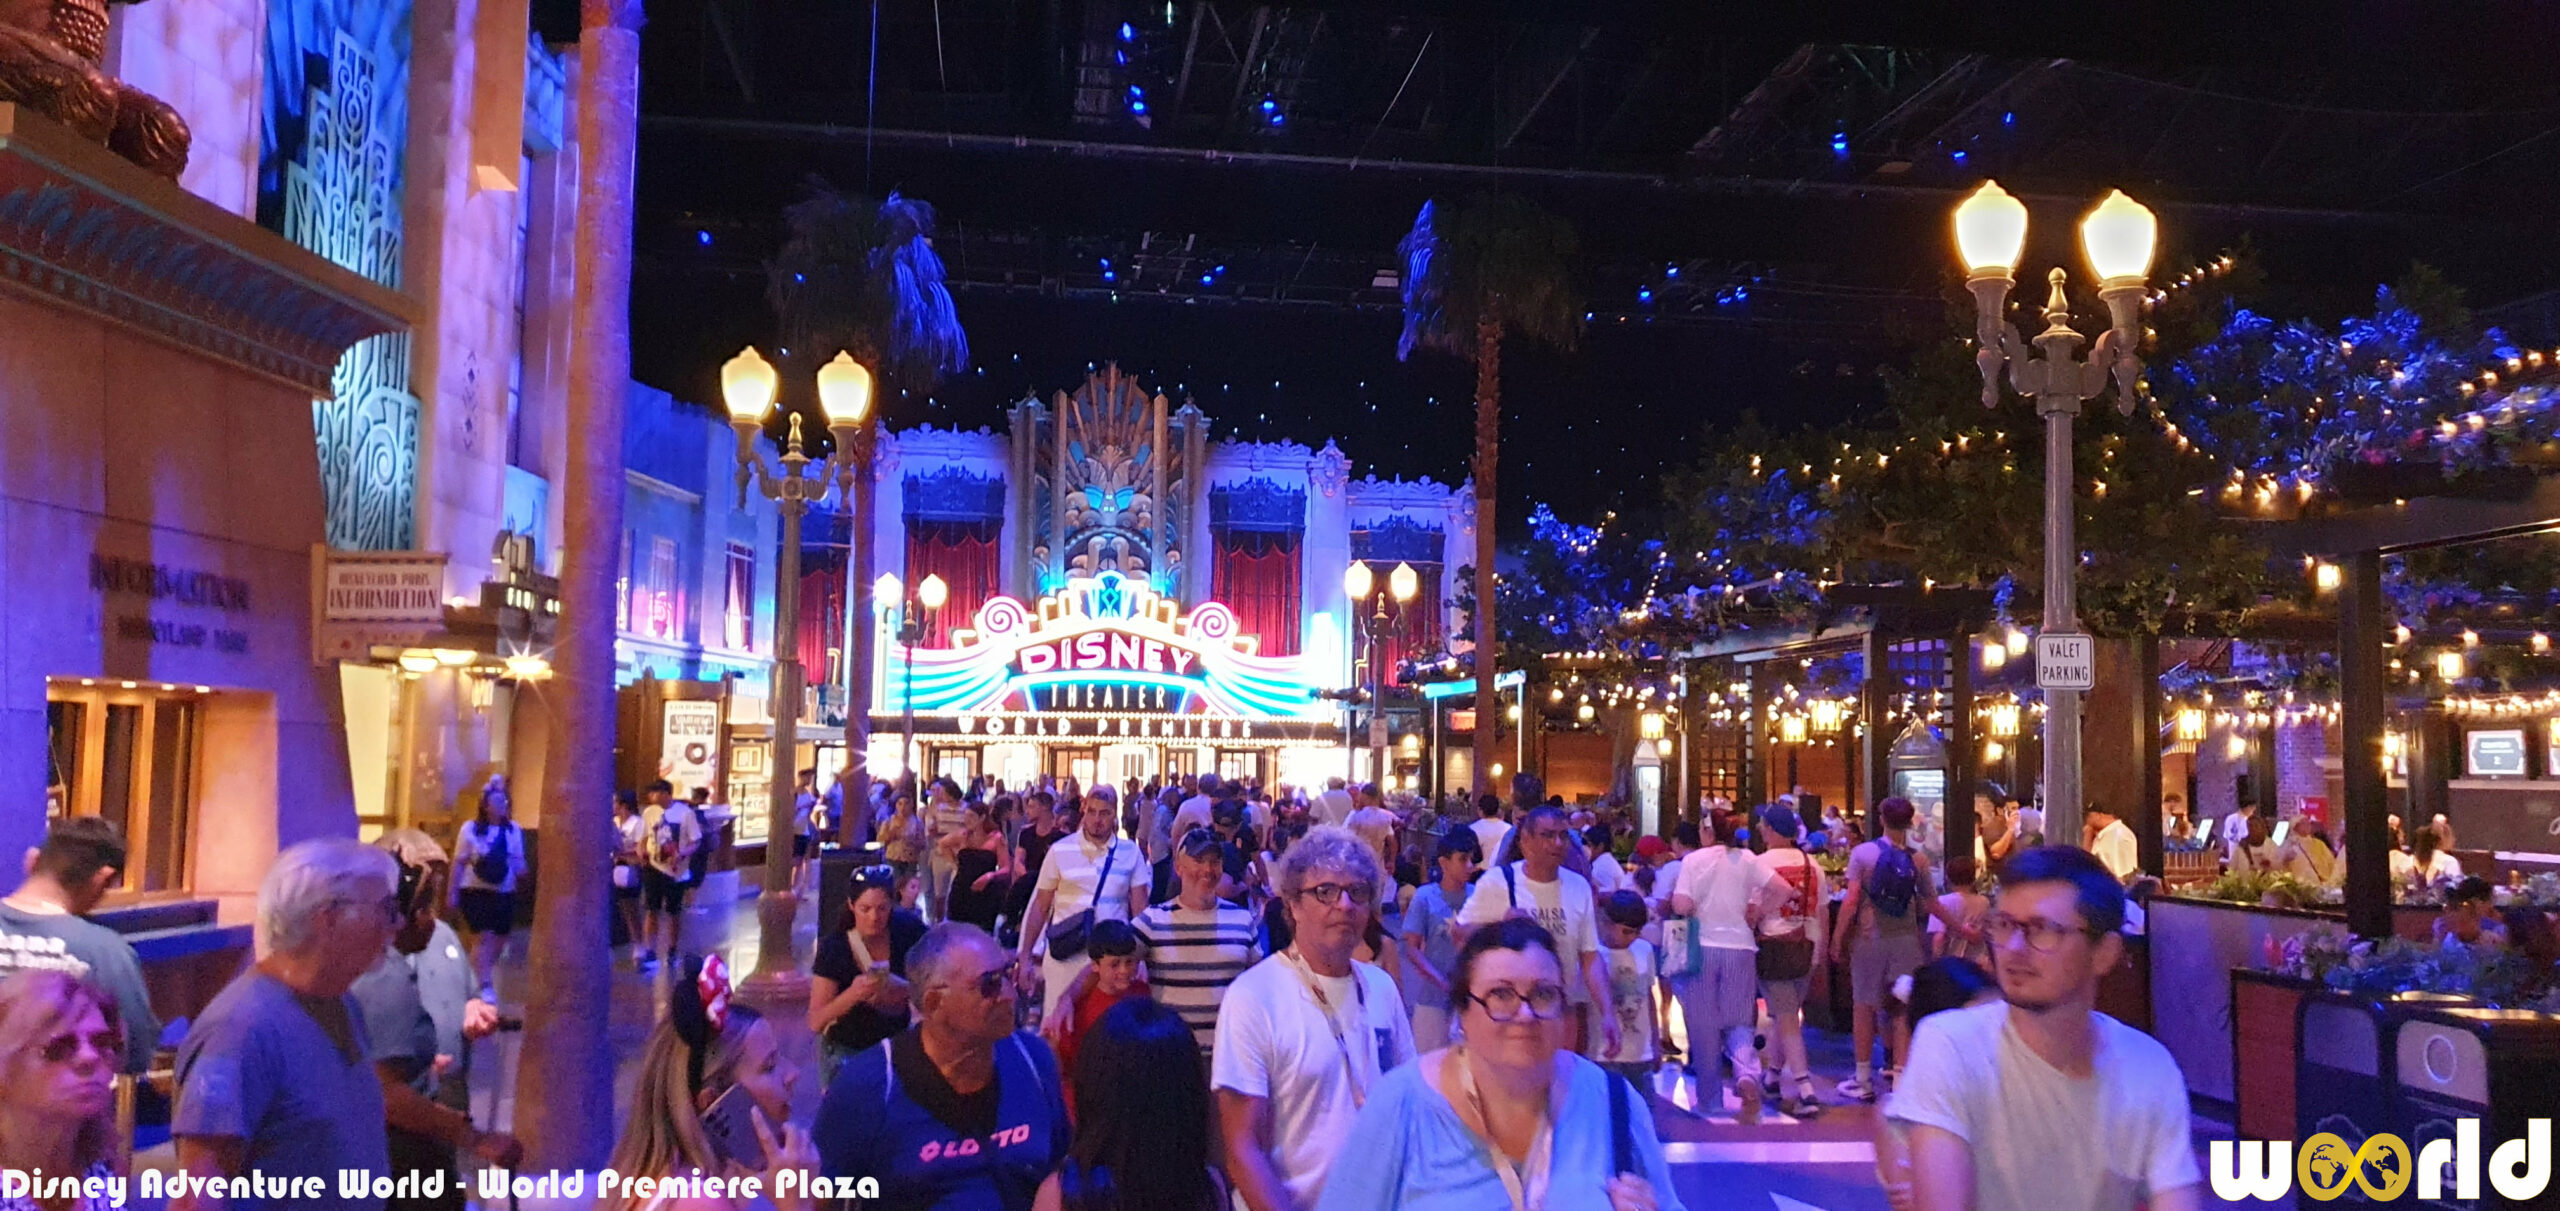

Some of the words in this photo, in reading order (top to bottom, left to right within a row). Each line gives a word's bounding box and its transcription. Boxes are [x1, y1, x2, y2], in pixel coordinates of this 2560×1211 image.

[329, 589, 437, 609] INFORMATION
[1020, 631, 1194, 675] DISNEY
[2048, 643, 2080, 658] VALET
[2042, 666, 2088, 681] PARKING
[1051, 683, 1166, 709] THEATER
[957, 715, 1072, 736] WORLD
[1097, 717, 1252, 738] PREMIERE
[1531, 908, 1567, 921] SALSA
